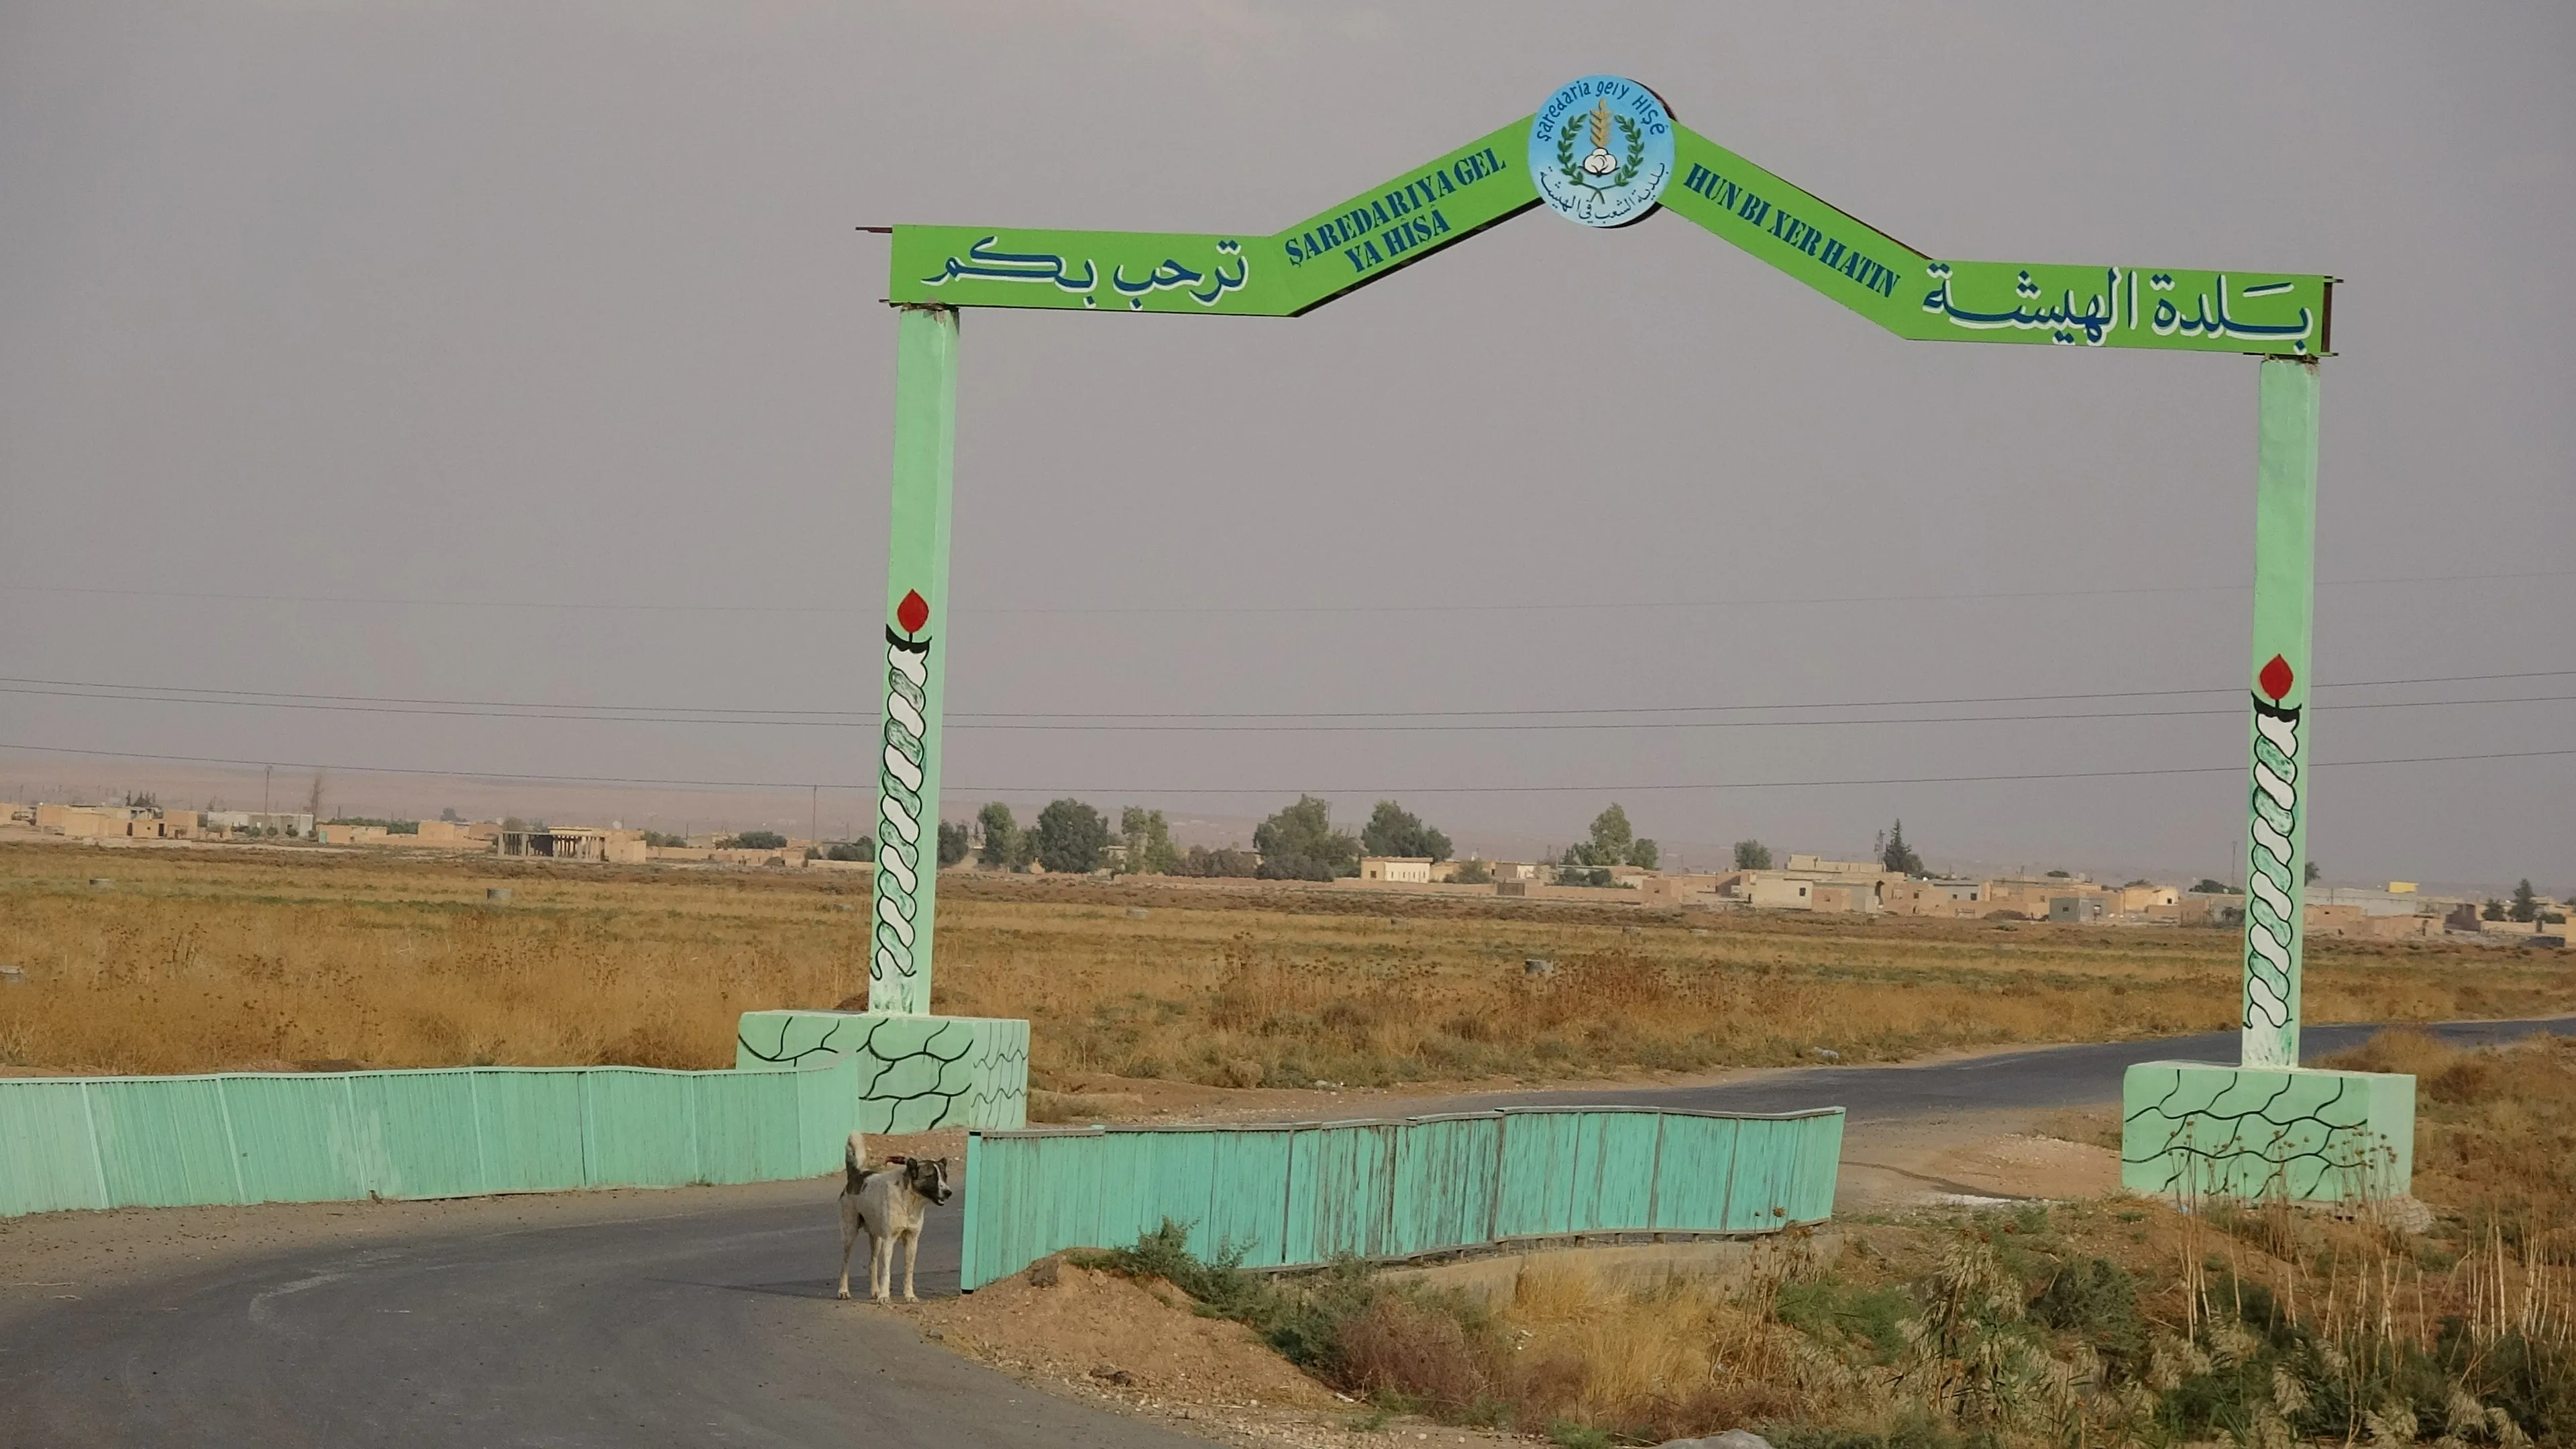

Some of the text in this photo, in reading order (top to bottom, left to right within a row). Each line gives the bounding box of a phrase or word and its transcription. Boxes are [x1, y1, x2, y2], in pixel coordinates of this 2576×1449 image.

[1453, 147, 1506, 186] GEL
[1682, 162, 1744, 211] HUN
[1737, 193, 1772, 227] BI
[1766, 209, 1823, 257] XER
[920, 235, 1250, 311] ترحب بكم
[1344, 240, 1384, 273] YA
[1921, 262, 2139, 346] الهيشة
